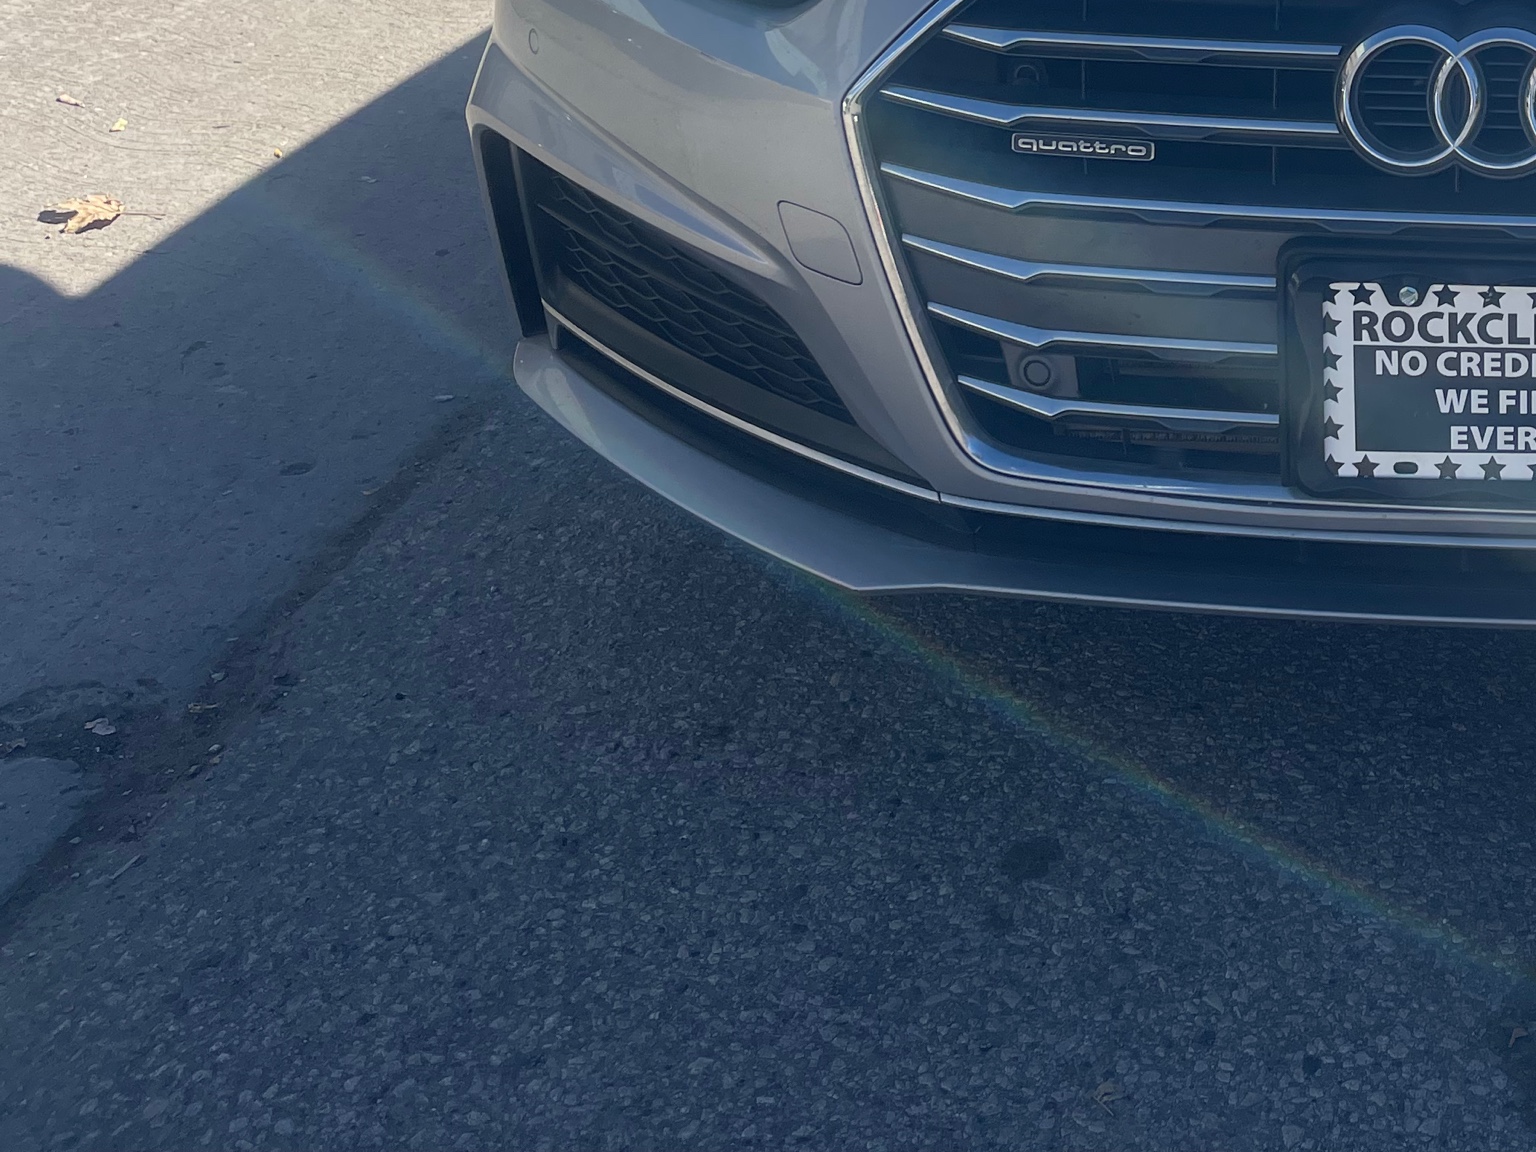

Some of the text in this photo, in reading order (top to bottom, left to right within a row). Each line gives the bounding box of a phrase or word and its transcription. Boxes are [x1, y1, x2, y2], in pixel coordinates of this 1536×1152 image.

[1016, 137, 1148, 157] quattro
[1375, 350, 1428, 377] NO
[1435, 388, 1489, 415] WE
